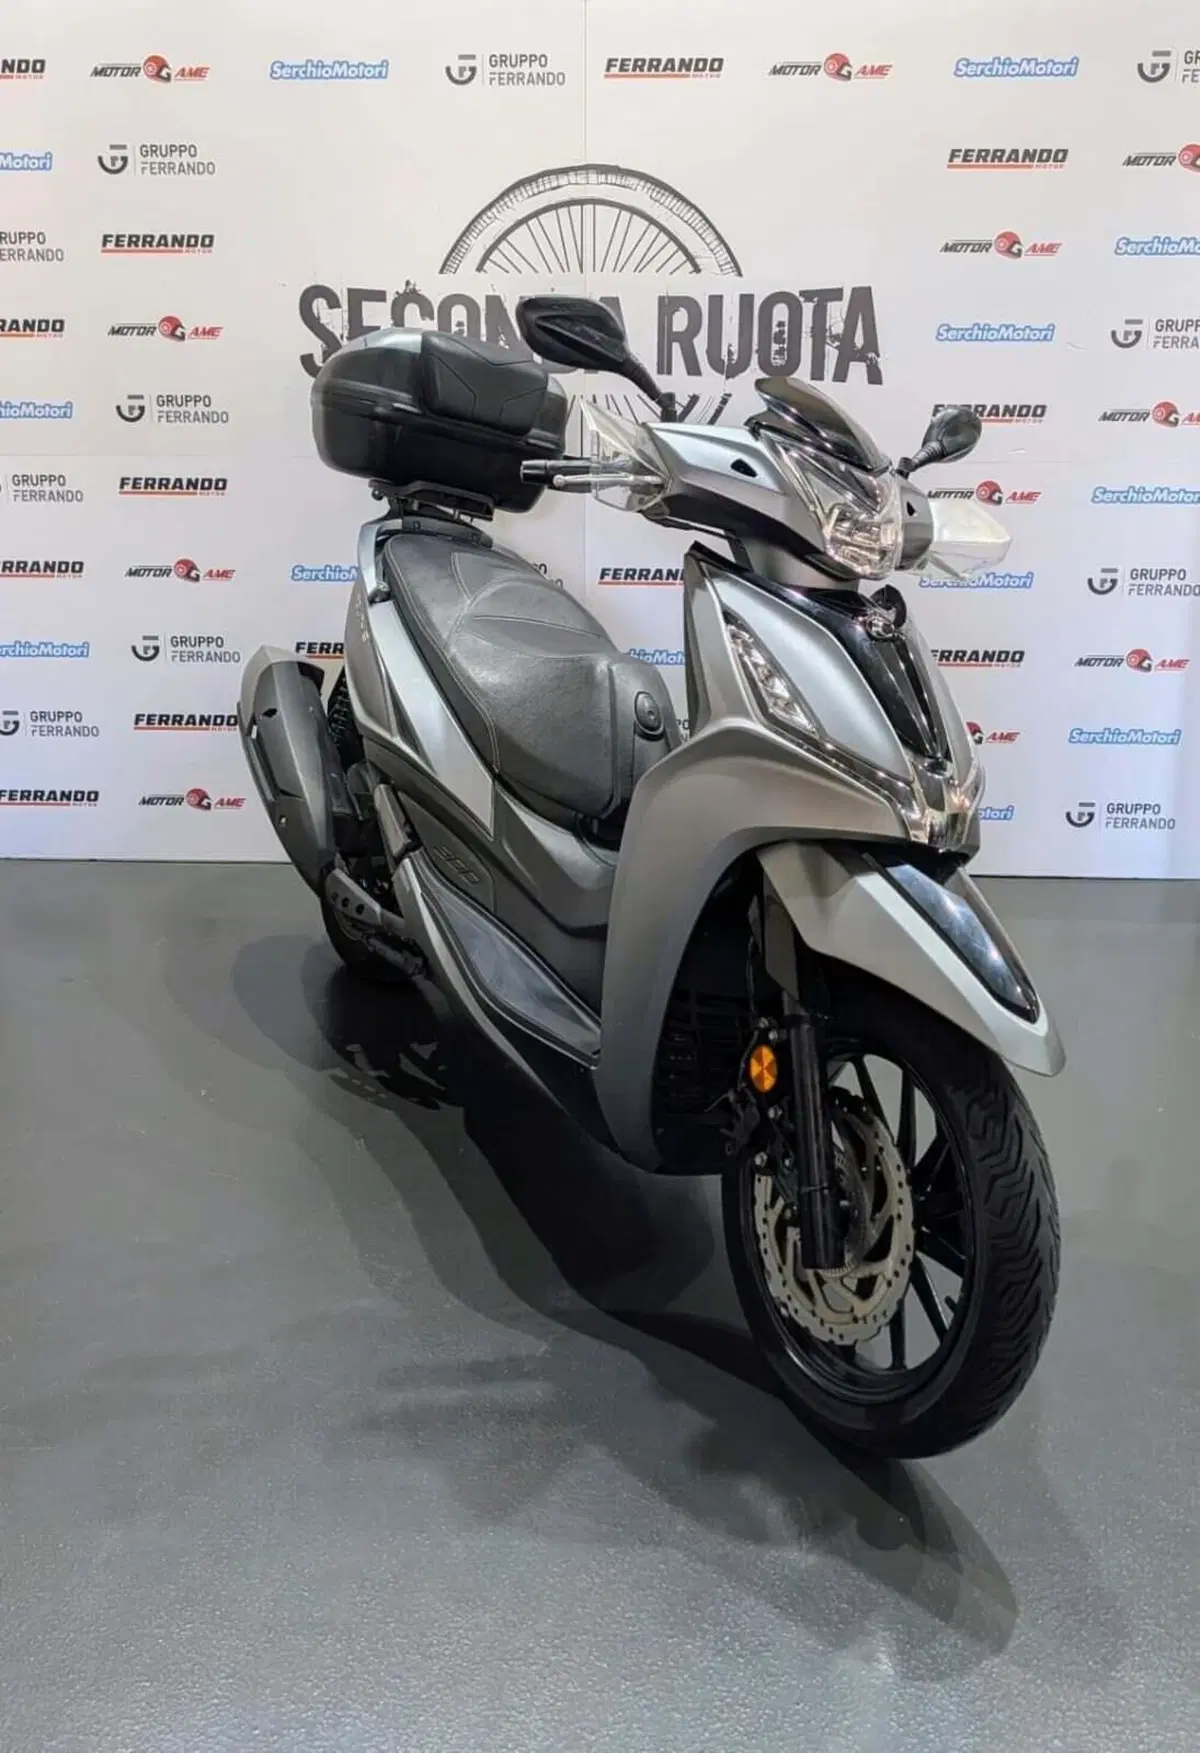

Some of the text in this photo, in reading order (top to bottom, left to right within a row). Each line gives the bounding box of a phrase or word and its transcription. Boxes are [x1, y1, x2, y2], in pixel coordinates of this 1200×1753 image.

[488, 54, 548, 68] GRUPPO
[606, 58, 724, 72] FERRANDO
[954, 57, 1079, 78] SerchioMotori
[90, 66, 141, 78] MOTOR
[270, 59, 389, 80] SerchioMotori
[768, 65, 821, 75] MOTOR
[489, 72, 566, 86] FERRANDO
[139, 144, 198, 158] GRUPPO
[948, 149, 1069, 163] FERRANDO
[1122, 155, 1176, 166] MOTOR
[141, 162, 216, 175] FERRANDO
[102, 234, 215, 248] FERRANDO
[940, 242, 993, 253] MOTOR
[108, 326, 156, 337] MOTOR
[656, 285, 883, 386] RUOTA
[936, 323, 1056, 343] SerchioMotori
[156, 395, 211, 408] GRUPPO
[157, 410, 229, 424] FERRANDO
[1099, 411, 1150, 422] MOTOR
[12, 474, 66, 488] GRUPPO
[119, 477, 228, 491] FERRANDO
[13, 490, 84, 503] FERRANDO
[0, 560, 84, 574] RRANDO
[127, 567, 172, 578] MOTOR
[600, 567, 684, 581] FERRAN
[1130, 568, 1187, 581] GRUPPO
[1128, 583, 1200, 597] FERRANDO
[170, 636, 224, 649] GRUPPO
[171, 651, 241, 663] FERRANDO
[1075, 657, 1123, 667] MOTOR
[30, 711, 83, 723] GRUPPO
[134, 713, 238, 727] FERRANDO
[31, 724, 100, 737] FERRANDO
[1068, 727, 1182, 746] SerchioMotori
[138, 797, 184, 806] MOTOR
[1106, 803, 1161, 816] GRUPPO
[1105, 817, 1176, 831] FERRANDO
